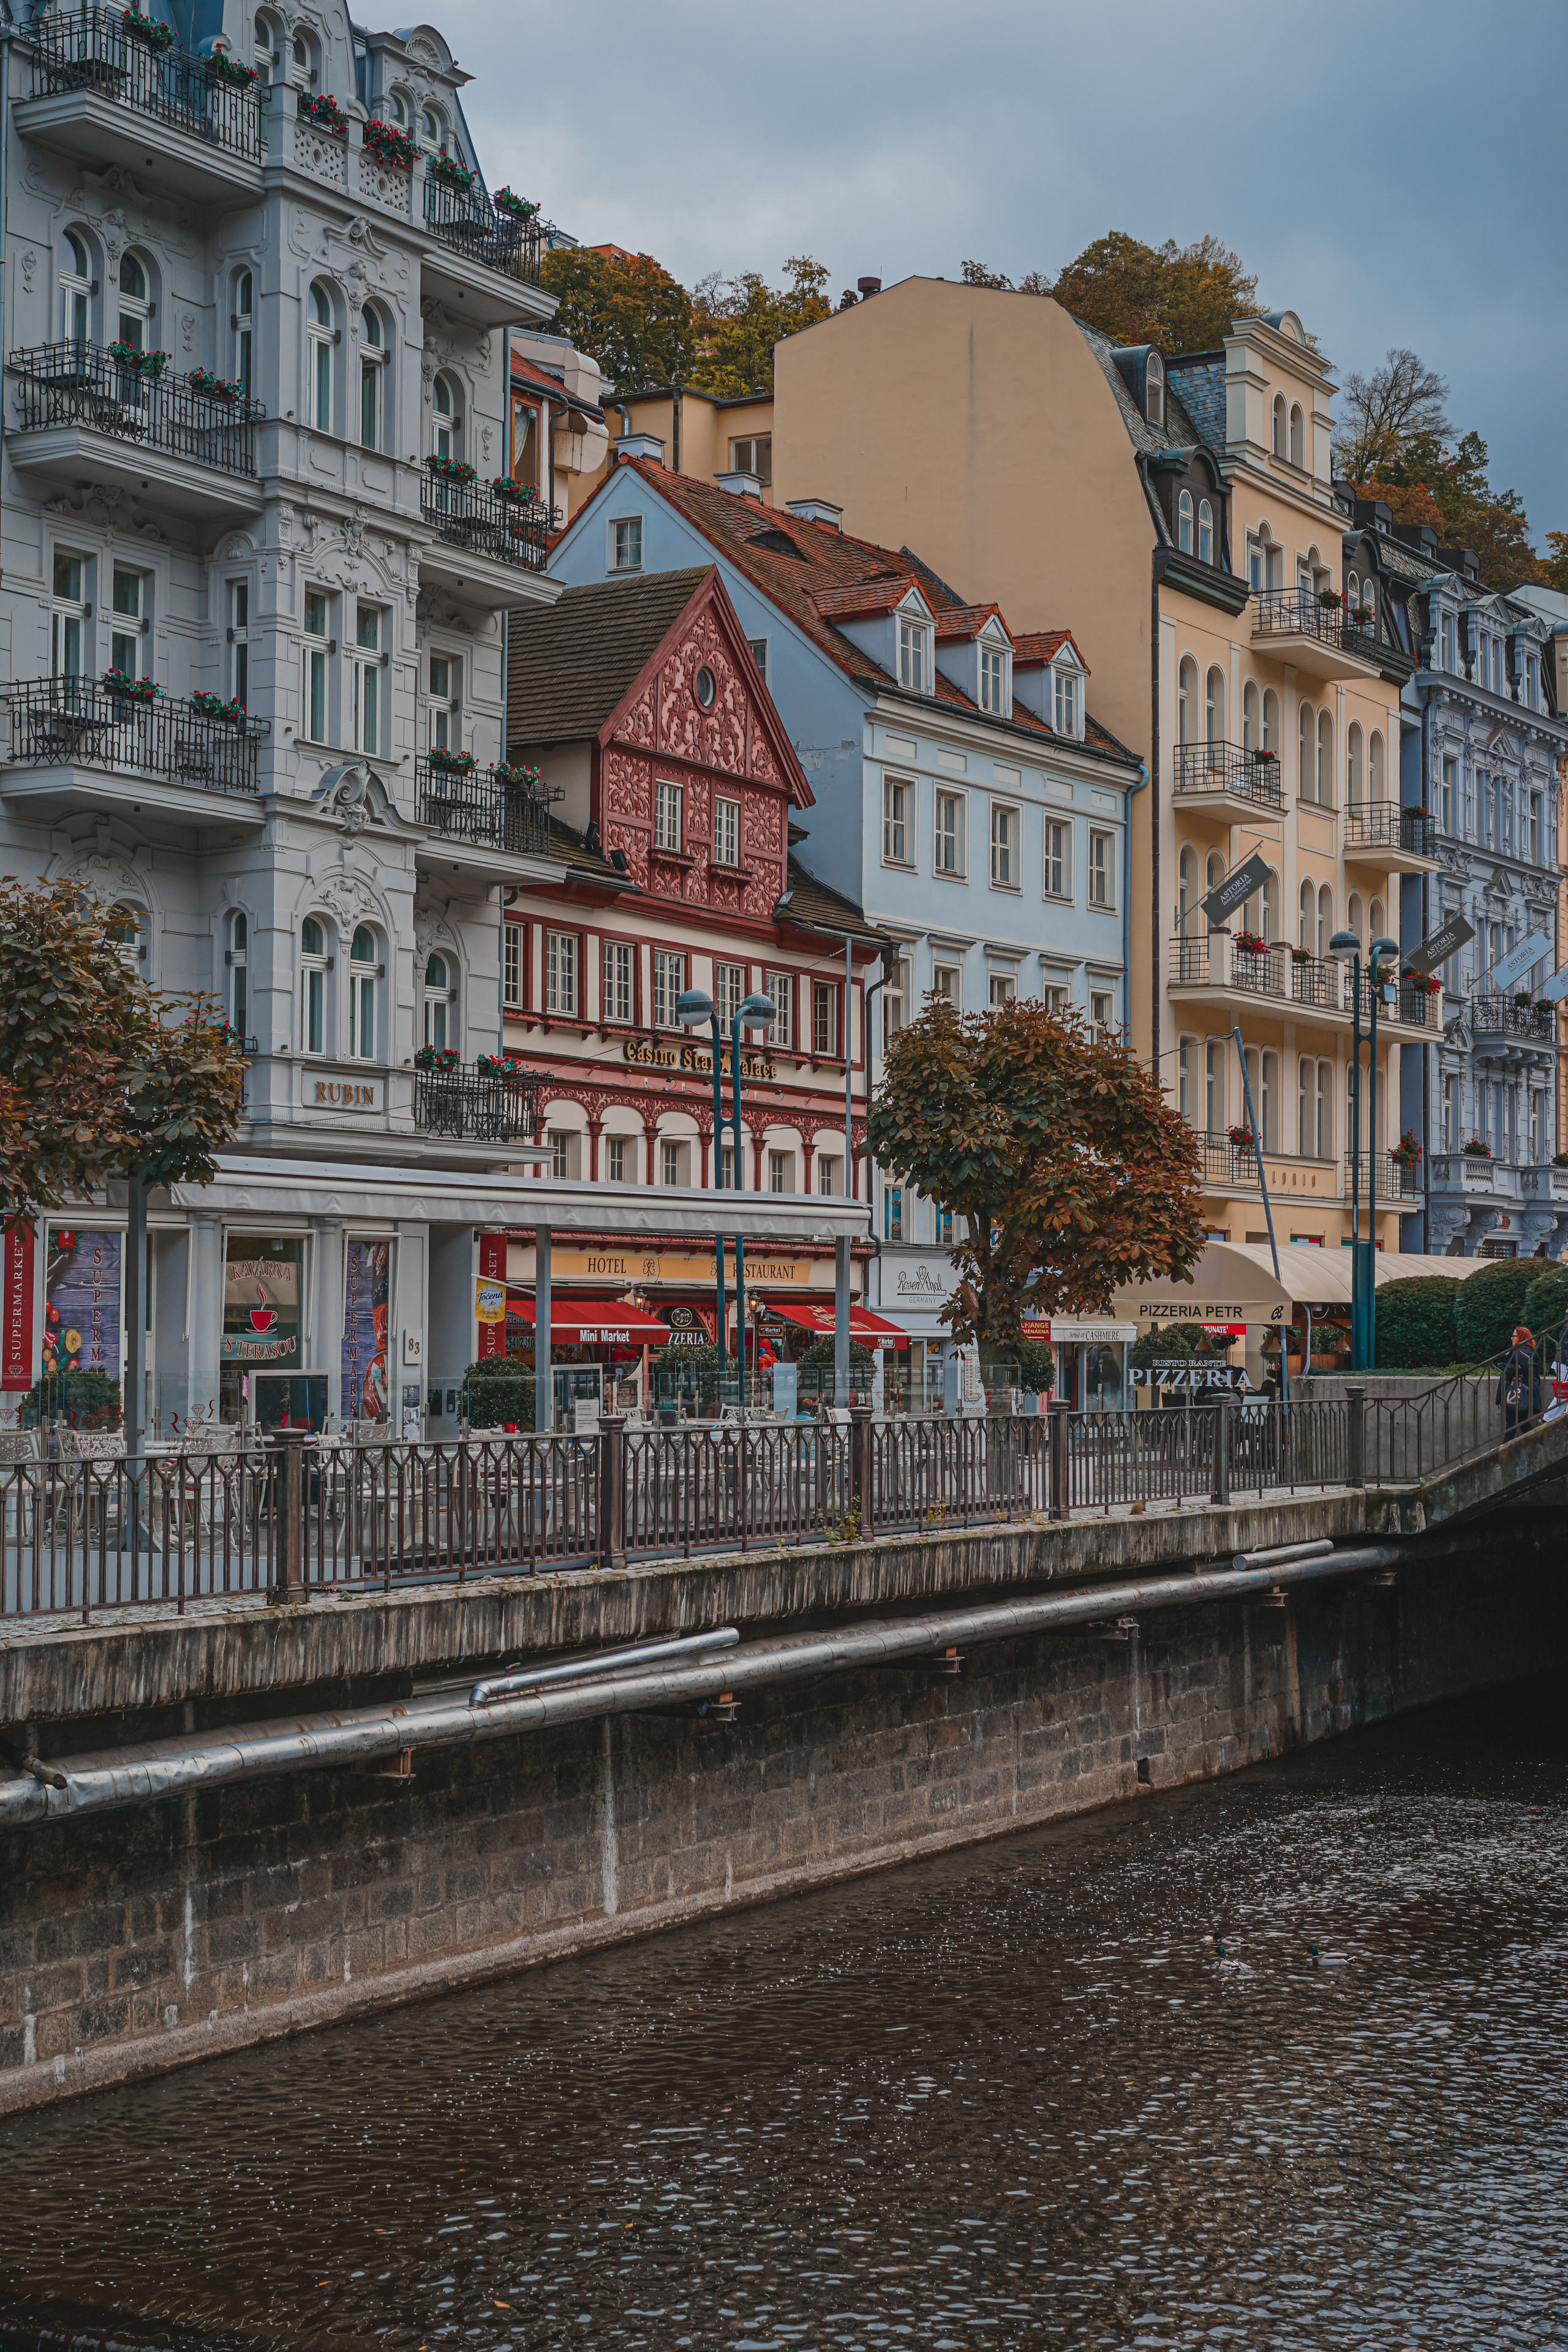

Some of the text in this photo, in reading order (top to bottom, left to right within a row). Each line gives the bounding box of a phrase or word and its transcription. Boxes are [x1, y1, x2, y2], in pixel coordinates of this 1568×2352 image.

[1220, 873, 1250, 903] ASTORIA
[1223, 896, 1232, 906] Hotel
[1427, 932, 1454, 957] ASTORIA
[1507, 947, 1533, 970] ASTORIA
[624, 1041, 677, 1065] Casino
[734, 1056, 777, 1079] alace
[316, 1081, 375, 1105] RUBIN
[230, 1256, 292, 1283] KAVÁRNA
[587, 1257, 627, 1274] HOTEL
[897, 1270, 947, 1295] Rosenthal
[11, 1235, 23, 1360] SUPERMARKET
[478, 1290, 503, 1303] Točená
[90, 1248, 103, 1372] SUPERM
[1140, 1305, 1243, 1317] PIZZERIA PETR
[224, 1335, 296, 1360] S TERASOU
[349, 1256, 358, 1417] SUPERMARK
[409, 1338, 420, 1355] 83
[579, 1330, 630, 1342] Mini Market
[1085, 1331, 1120, 1341] CASHMERE
[1127, 1368, 1253, 1387] PIZZERIA
